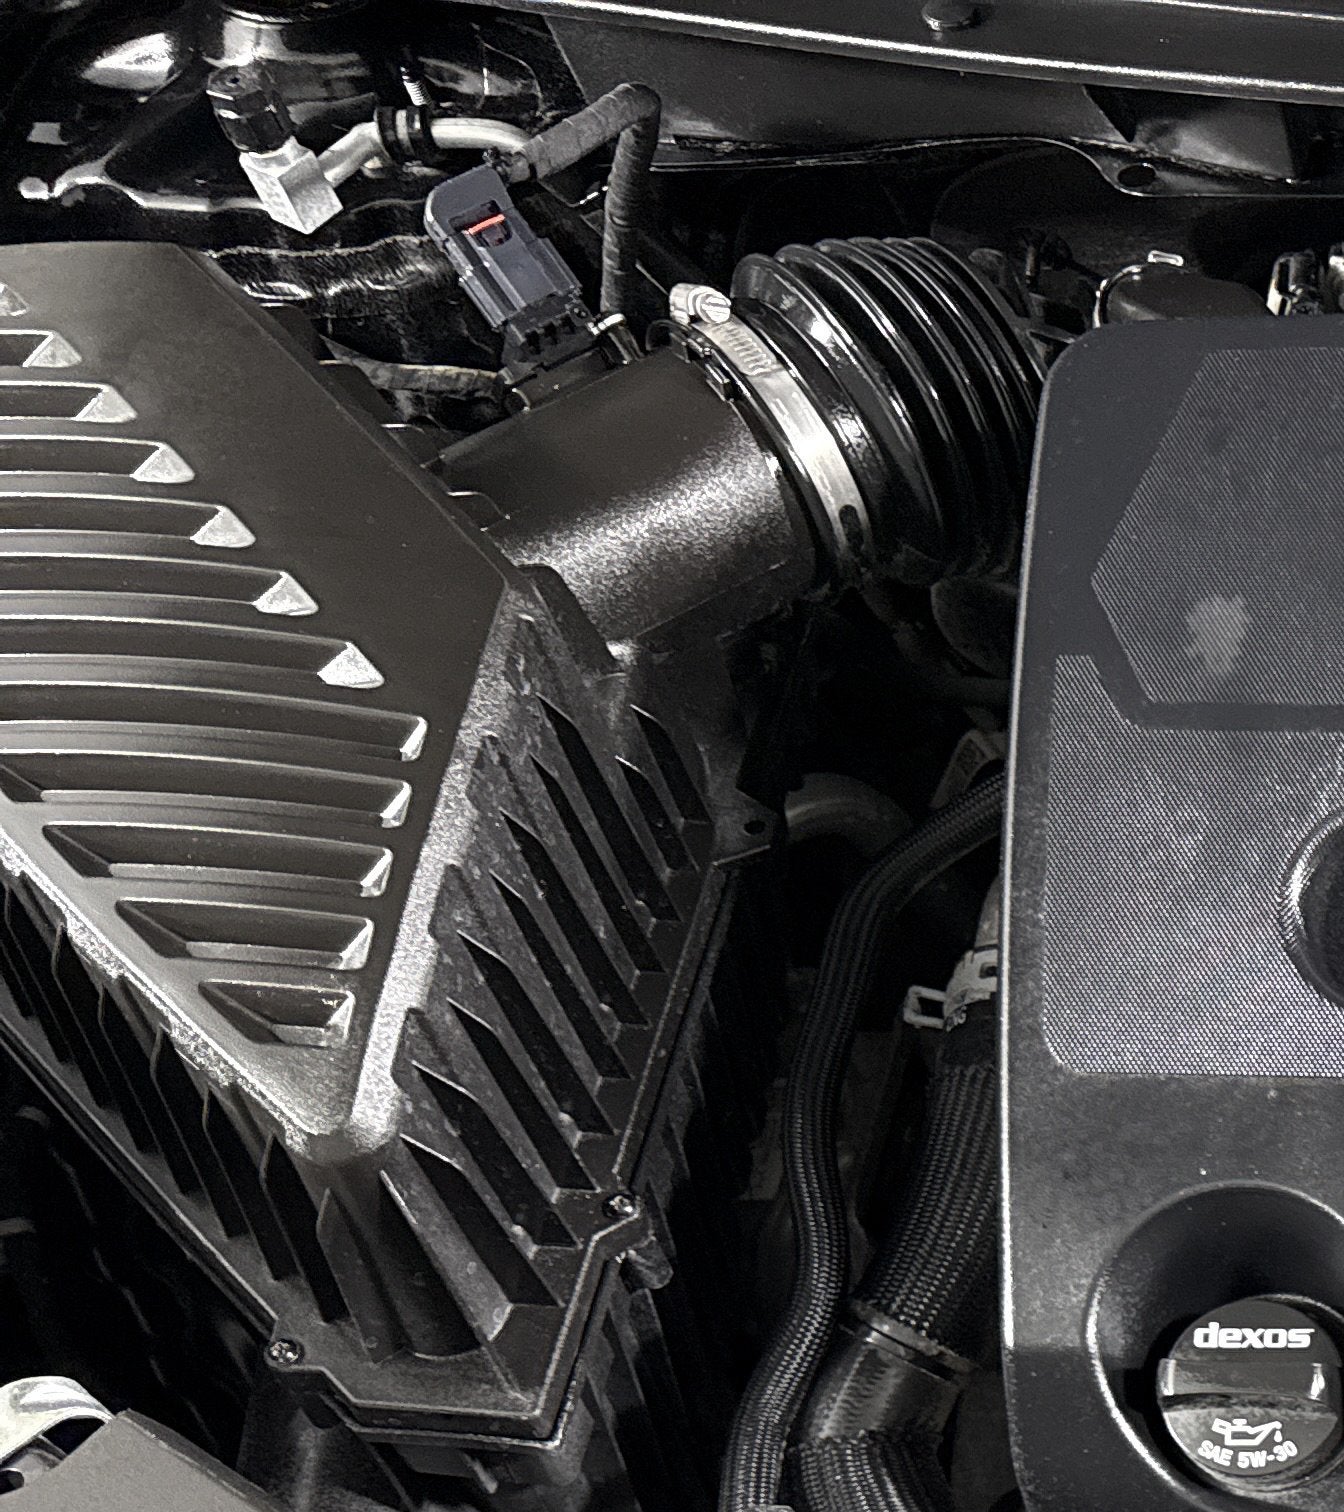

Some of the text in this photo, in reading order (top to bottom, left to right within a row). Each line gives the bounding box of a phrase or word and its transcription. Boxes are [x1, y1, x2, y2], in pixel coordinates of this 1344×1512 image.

[1193, 1321, 1315, 1349] dexos
[1198, 1439, 1298, 1468] SAE 5W-30
